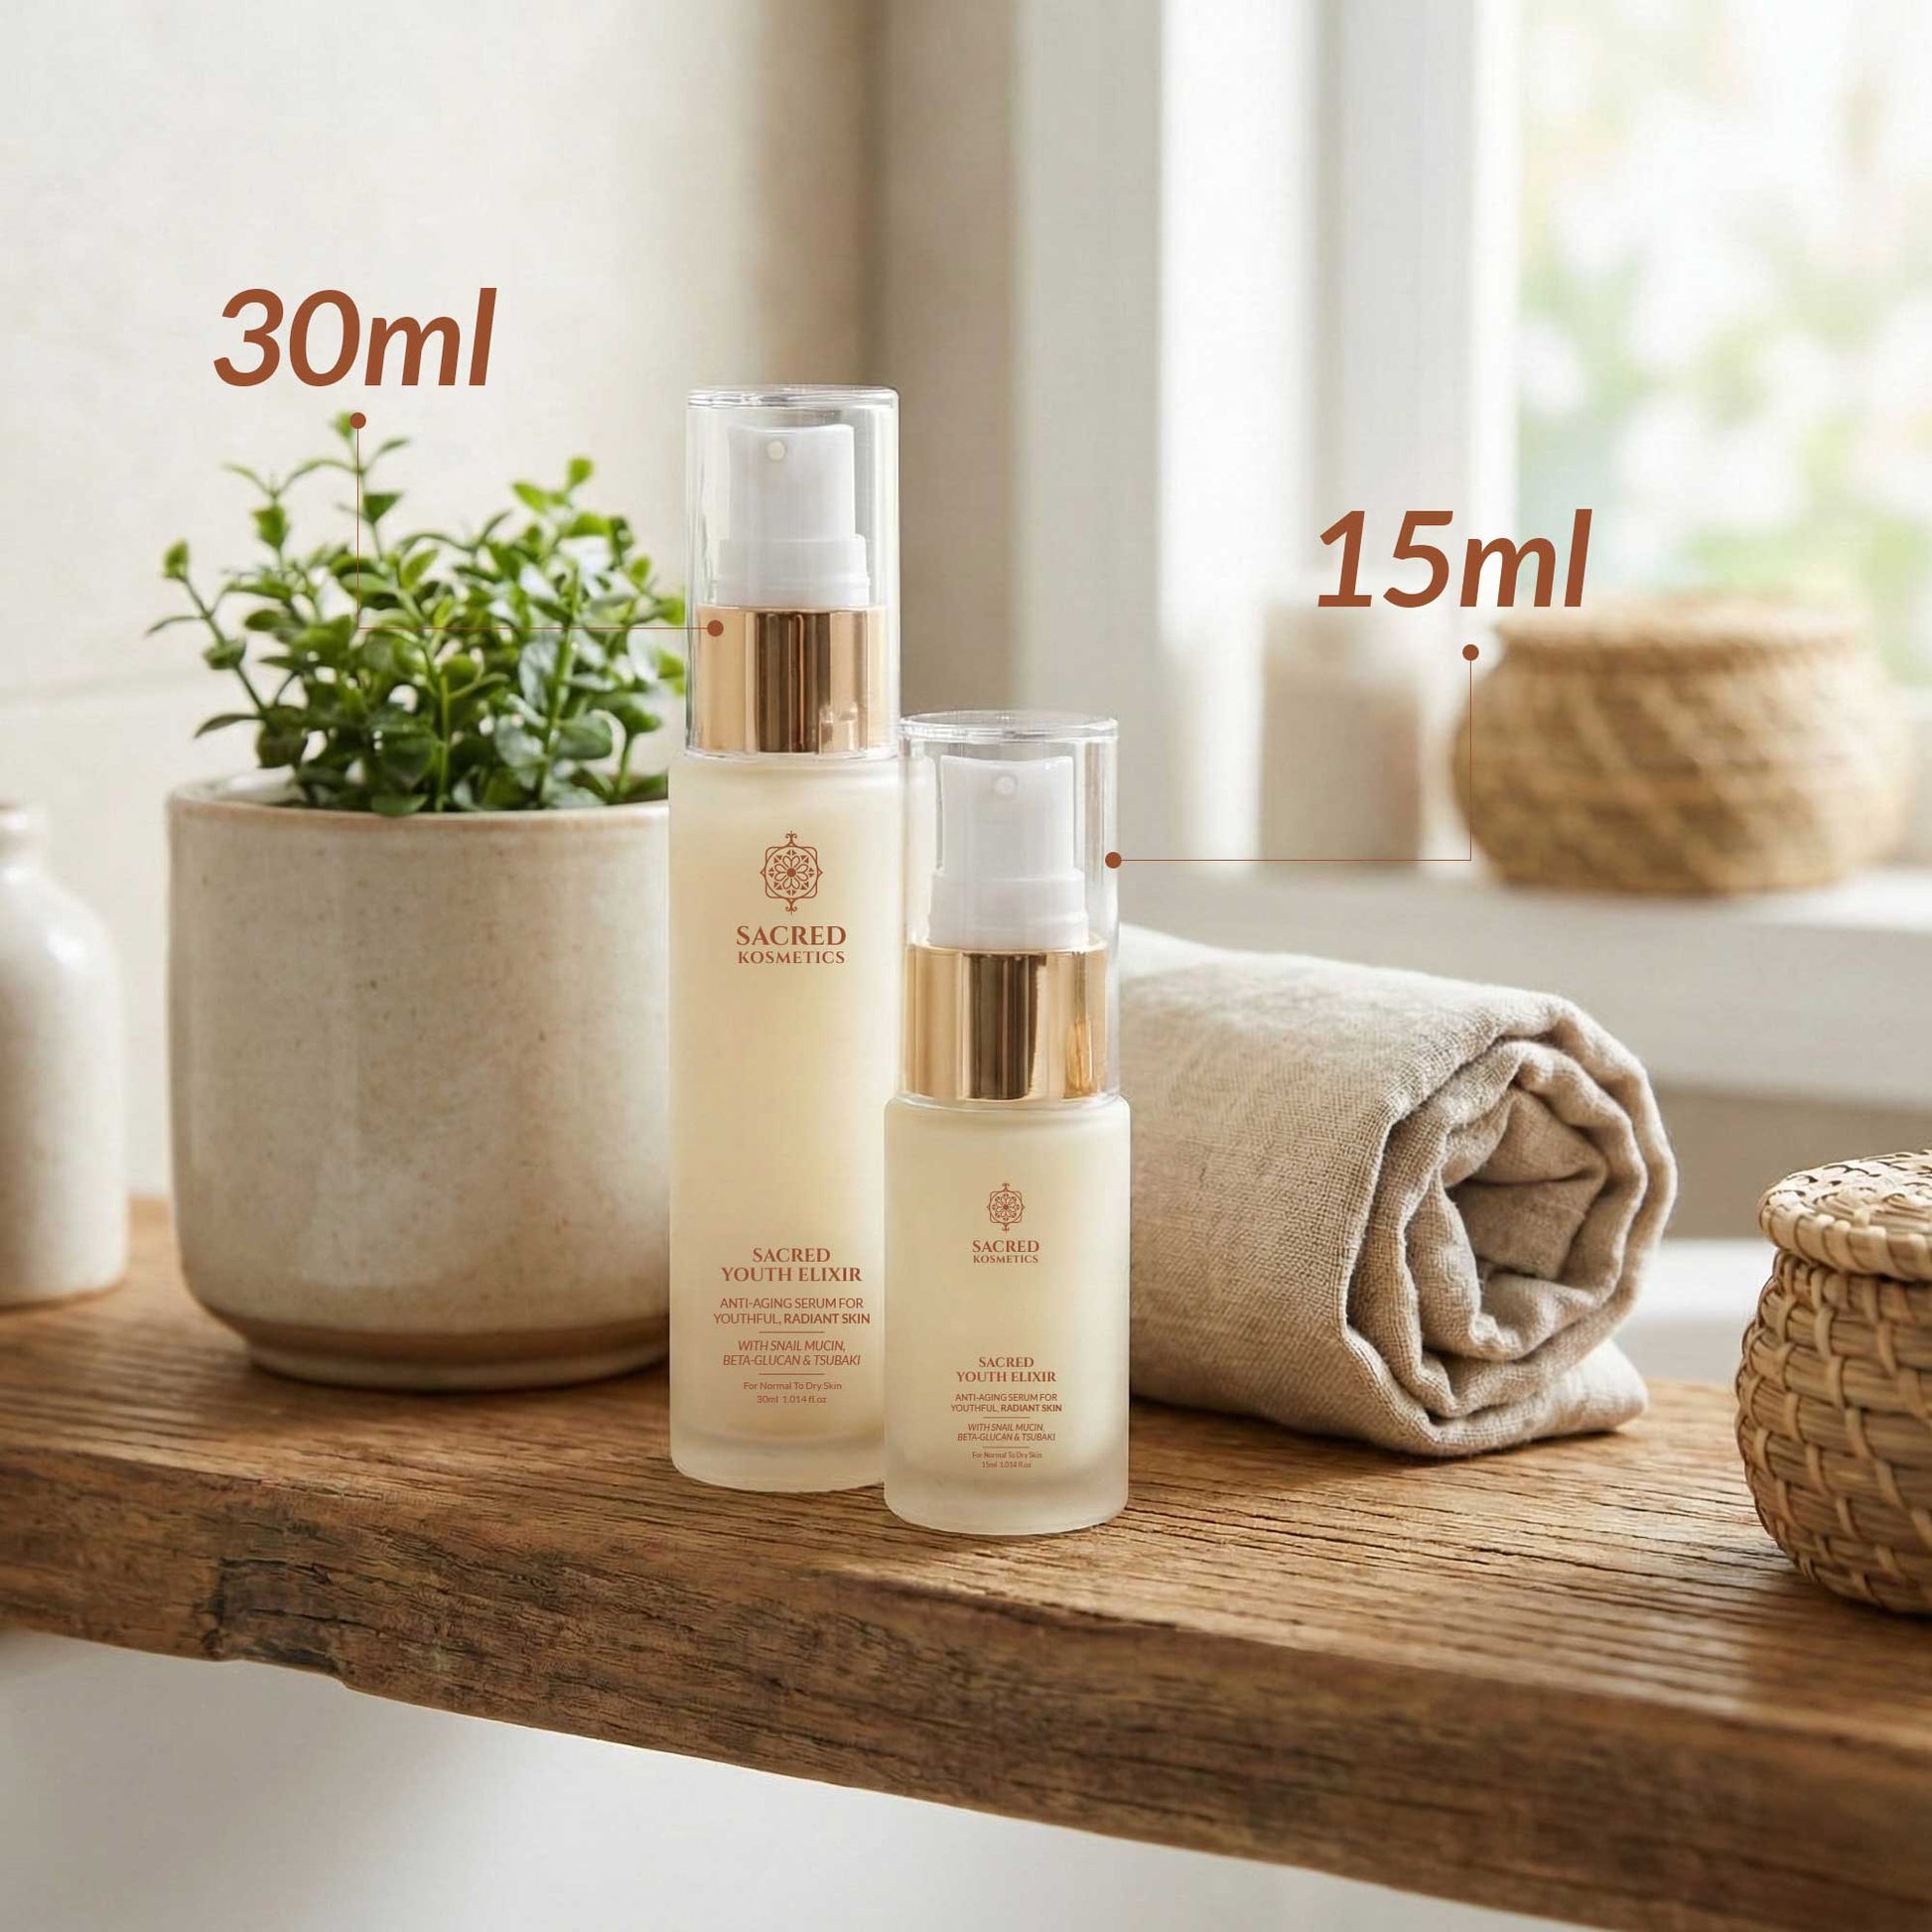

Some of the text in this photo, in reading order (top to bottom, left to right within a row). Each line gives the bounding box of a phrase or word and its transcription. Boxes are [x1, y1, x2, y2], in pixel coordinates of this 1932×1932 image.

[736, 925, 847, 946] SACRED
[738, 950, 846, 964] KOSMETICS
[972, 1239, 1039, 1253] SACRED
[753, 1247, 831, 1263] SACRED
[973, 1254, 1038, 1264] KOSMETICS
[721, 1267, 863, 1282] YOUTH ELIXIR
[720, 1298, 864, 1309] ANTI-AGING SERUM FOR
[714, 1312, 871, 1325] YOUTHFUL, RADIANT SKIN
[738, 1340, 846, 1352] WITH SNAIL MUCIN,
[723, 1354, 861, 1366] BETA-GLUCAN & TSUBAKI
[978, 1356, 1035, 1368] SACRED
[956, 1371, 1056, 1383] YOUTH ELIXIR
[744, 1381, 842, 1392] For Normal To Dry Skin
[757, 1395, 778, 1404] 30ml
[782, 1395, 806, 1404] 1.014
[955, 1393, 1058, 1402] ANTI-AGING SERUM FOR
[951, 1404, 1000, 1413] YOUTHFUL,
[968, 1423, 991, 1432] WITH
[991, 1423, 1014, 1432] SNAIL
[957, 1433, 1055, 1442] BETA-GLUCAN & TSUBAKI
